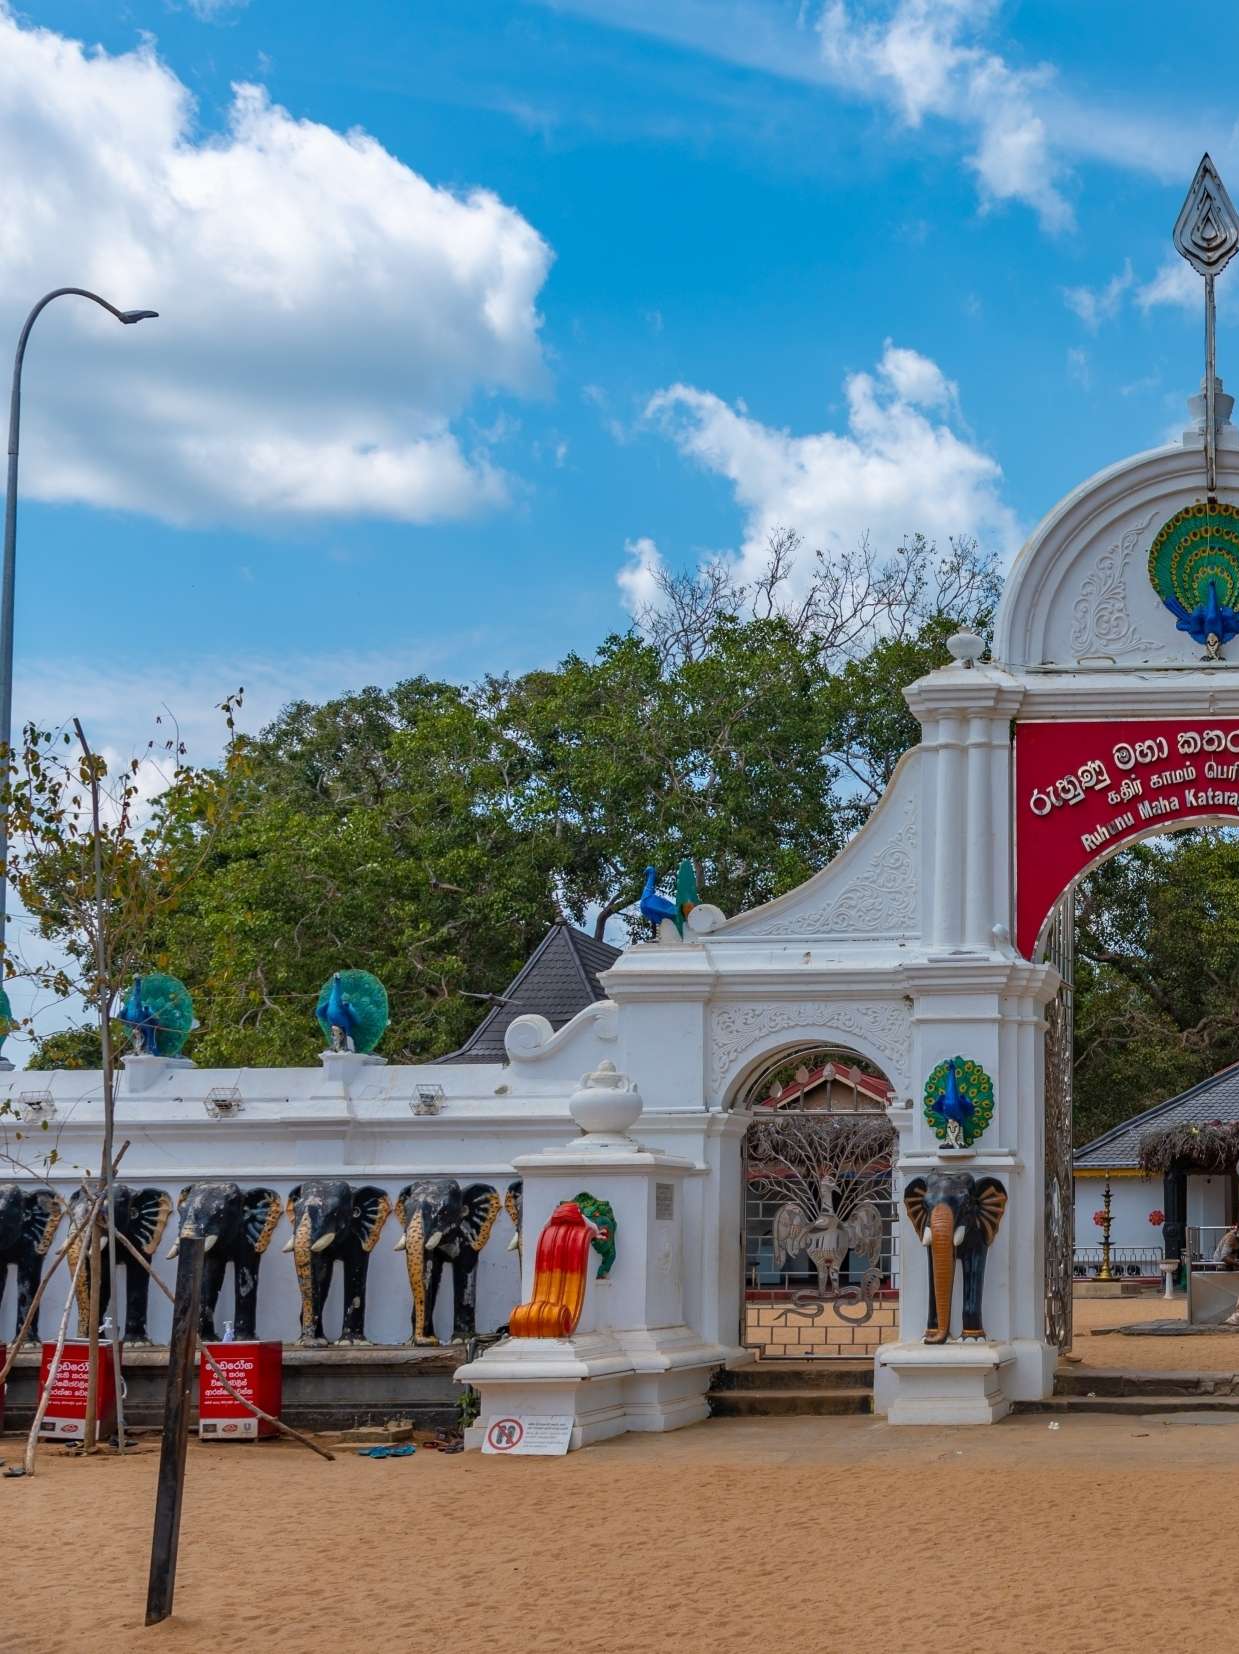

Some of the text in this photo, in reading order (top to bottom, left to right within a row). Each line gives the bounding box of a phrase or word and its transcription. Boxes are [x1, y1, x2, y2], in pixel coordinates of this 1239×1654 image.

[1029, 759, 1112, 816] රුහුණු
[1112, 736, 1169, 771] මහා
[1107, 774, 1143, 805] கதிர்
[1150, 760, 1197, 789] காமம்
[1080, 811, 1135, 852] Ruhunu
[1138, 794, 1180, 821] Maha
